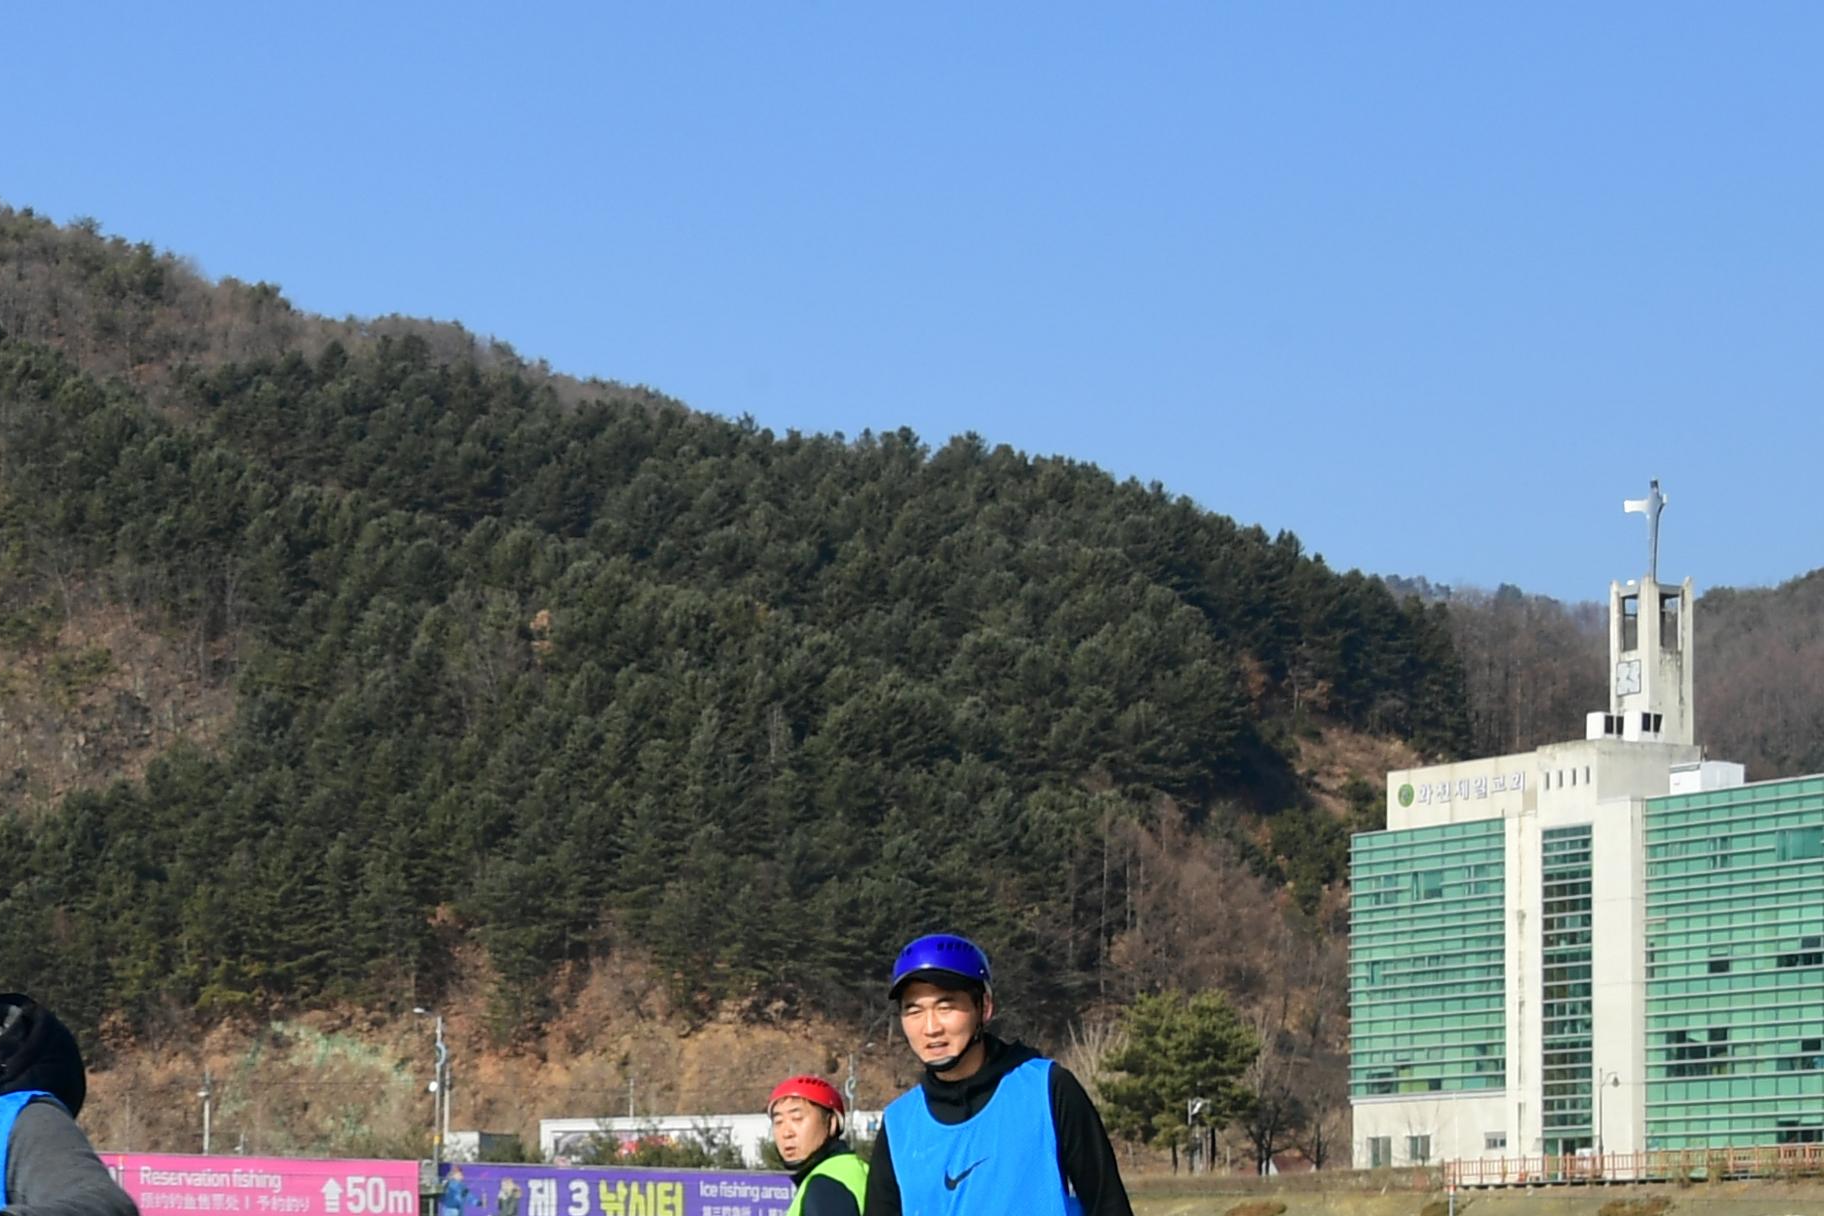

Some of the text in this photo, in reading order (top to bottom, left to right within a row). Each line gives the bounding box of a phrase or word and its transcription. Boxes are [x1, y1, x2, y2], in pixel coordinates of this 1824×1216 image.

[1417, 771, 1525, 805] 화천제일교회
[139, 1165, 229, 1188] Reservation
[232, 1168, 283, 1193] fishing
[699, 1180, 718, 1198] Ice
[719, 1181, 760, 1202] fishing
[761, 1185, 790, 1200] area
[345, 1176, 413, 1215] 50m
